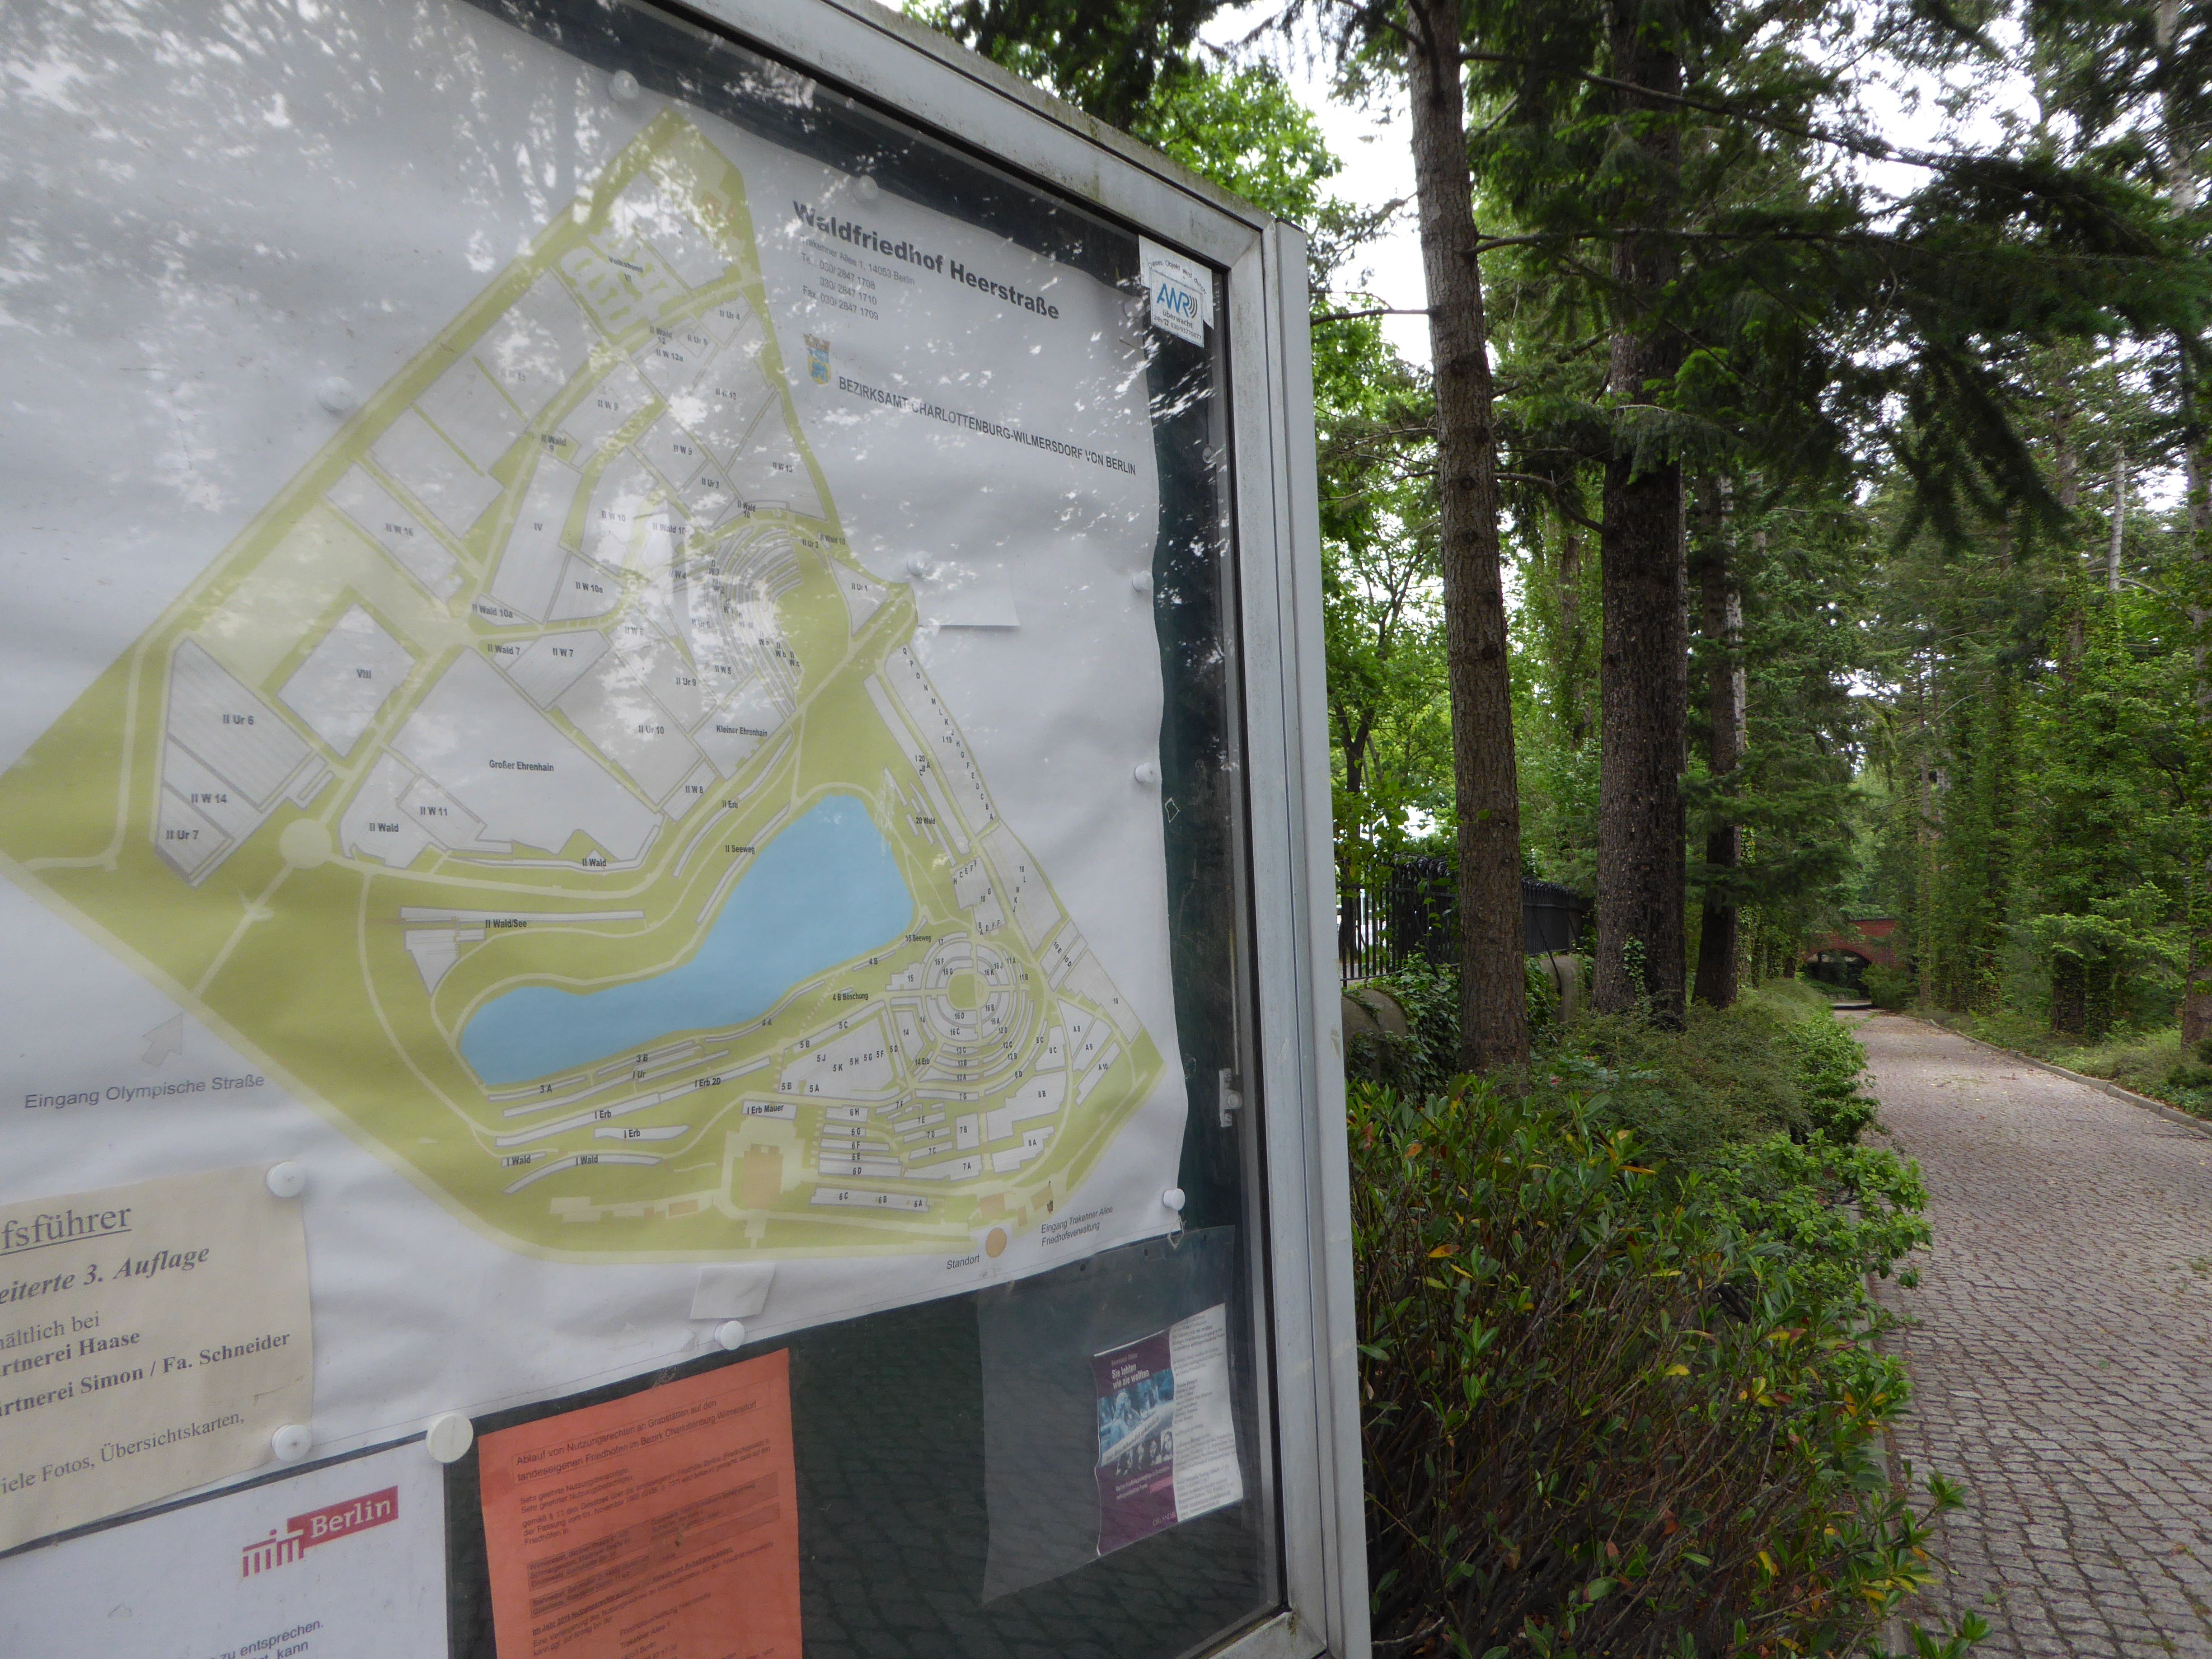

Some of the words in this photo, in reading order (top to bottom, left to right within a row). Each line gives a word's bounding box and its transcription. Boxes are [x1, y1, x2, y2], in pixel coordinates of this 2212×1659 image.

[793, 200, 943, 274] Waldfriedhof
[950, 260, 1059, 319] Heerstraße
[840, 252, 857, 267] Allee
[868, 263, 892, 279] 14053
[894, 271, 915, 286] Berlin
[837, 268, 854, 282] 2847
[858, 276, 876, 290] 1708
[1165, 260, 1180, 271] Objekt
[1194, 278, 1206, 295] durch
[838, 284, 855, 298] 2847
[858, 292, 877, 305] 1710
[839, 300, 857, 313] 2847
[860, 308, 879, 320] 1709
[1163, 309, 1194, 328] überwacht
[839, 376, 908, 408] BEZIRKSAMT
[911, 400, 1083, 459] CHARLOTTENBURG-WILMERSDORF
[1085, 450, 1103, 465] VON
[1106, 456, 1136, 475] BERLIN
[535, 523, 543, 531] IV
[590, 585, 603, 593] 10a
[479, 605, 497, 617] Wald
[495, 645, 513, 655] Wald
[516, 647, 520, 655] 7
[553, 647, 558, 656] II
[559, 648, 568, 656] W
[569, 649, 574, 657] 7
[223, 714, 230, 724] II
[233, 715, 246, 725] Ur
[717, 725, 738, 735] Kleiner
[740, 726, 768, 737] Ehrenhain
[489, 760, 515, 770] Großer
[516, 761, 554, 772] Ehrenhain
[191, 793, 197, 803] II
[200, 794, 211, 803] W
[214, 794, 227, 804] 14
[428, 807, 436, 815] W
[438, 807, 448, 816] 11
[370, 823, 375, 831] II
[377, 823, 398, 832] Wald
[166, 830, 173, 839] II
[176, 830, 190, 840] Ur
[192, 830, 199, 840] 7
[732, 845, 755, 854] Seeweg
[590, 859, 607, 867] Wald
[493, 919, 527, 928] Wald/See
[699, 1079, 710, 1087] Erb
[25, 1091, 99, 1109] Eingang
[106, 1080, 206, 1101] Olympische
[211, 1074, 264, 1090] Straße
[599, 1110, 612, 1118] Erb
[751, 1105, 762, 1113] Erb
[764, 1104, 784, 1113] Mauer
[628, 1129, 641, 1138] Erb
[510, 1156, 531, 1165] Wald
[580, 1155, 599, 1164] Wald
[1041, 1220, 1067, 1233] Eingang
[1069, 1211, 1099, 1226] Trakehner
[1099, 1205, 1113, 1216] Allee
[1042, 1222, 1100, 1247] Friedhofsverwaltung
[83, 1264, 103, 1285] 3.
[113, 1247, 209, 1279] Auflage
[947, 1254, 980, 1270] Standort
[71, 1311, 99, 1332] bei
[79, 1332, 140, 1356] Haase
[80, 1368, 144, 1394] Simon
[150, 1360, 156, 1378] /
[163, 1356, 193, 1374] Fa.
[200, 1333, 291, 1366] Schneider
[1131, 1369, 1149, 1382] wollten
[703, 1400, 717, 1410] den
[641, 1432, 663, 1446] Bezirk
[42, 1457, 95, 1482] Fotos,
[100, 1411, 244, 1462] Übersichtskarten,
[310, 1497, 392, 1538] Berlin
[240, 1620, 323, 1656] entsprechen.
[277, 1641, 309, 1659] kann
